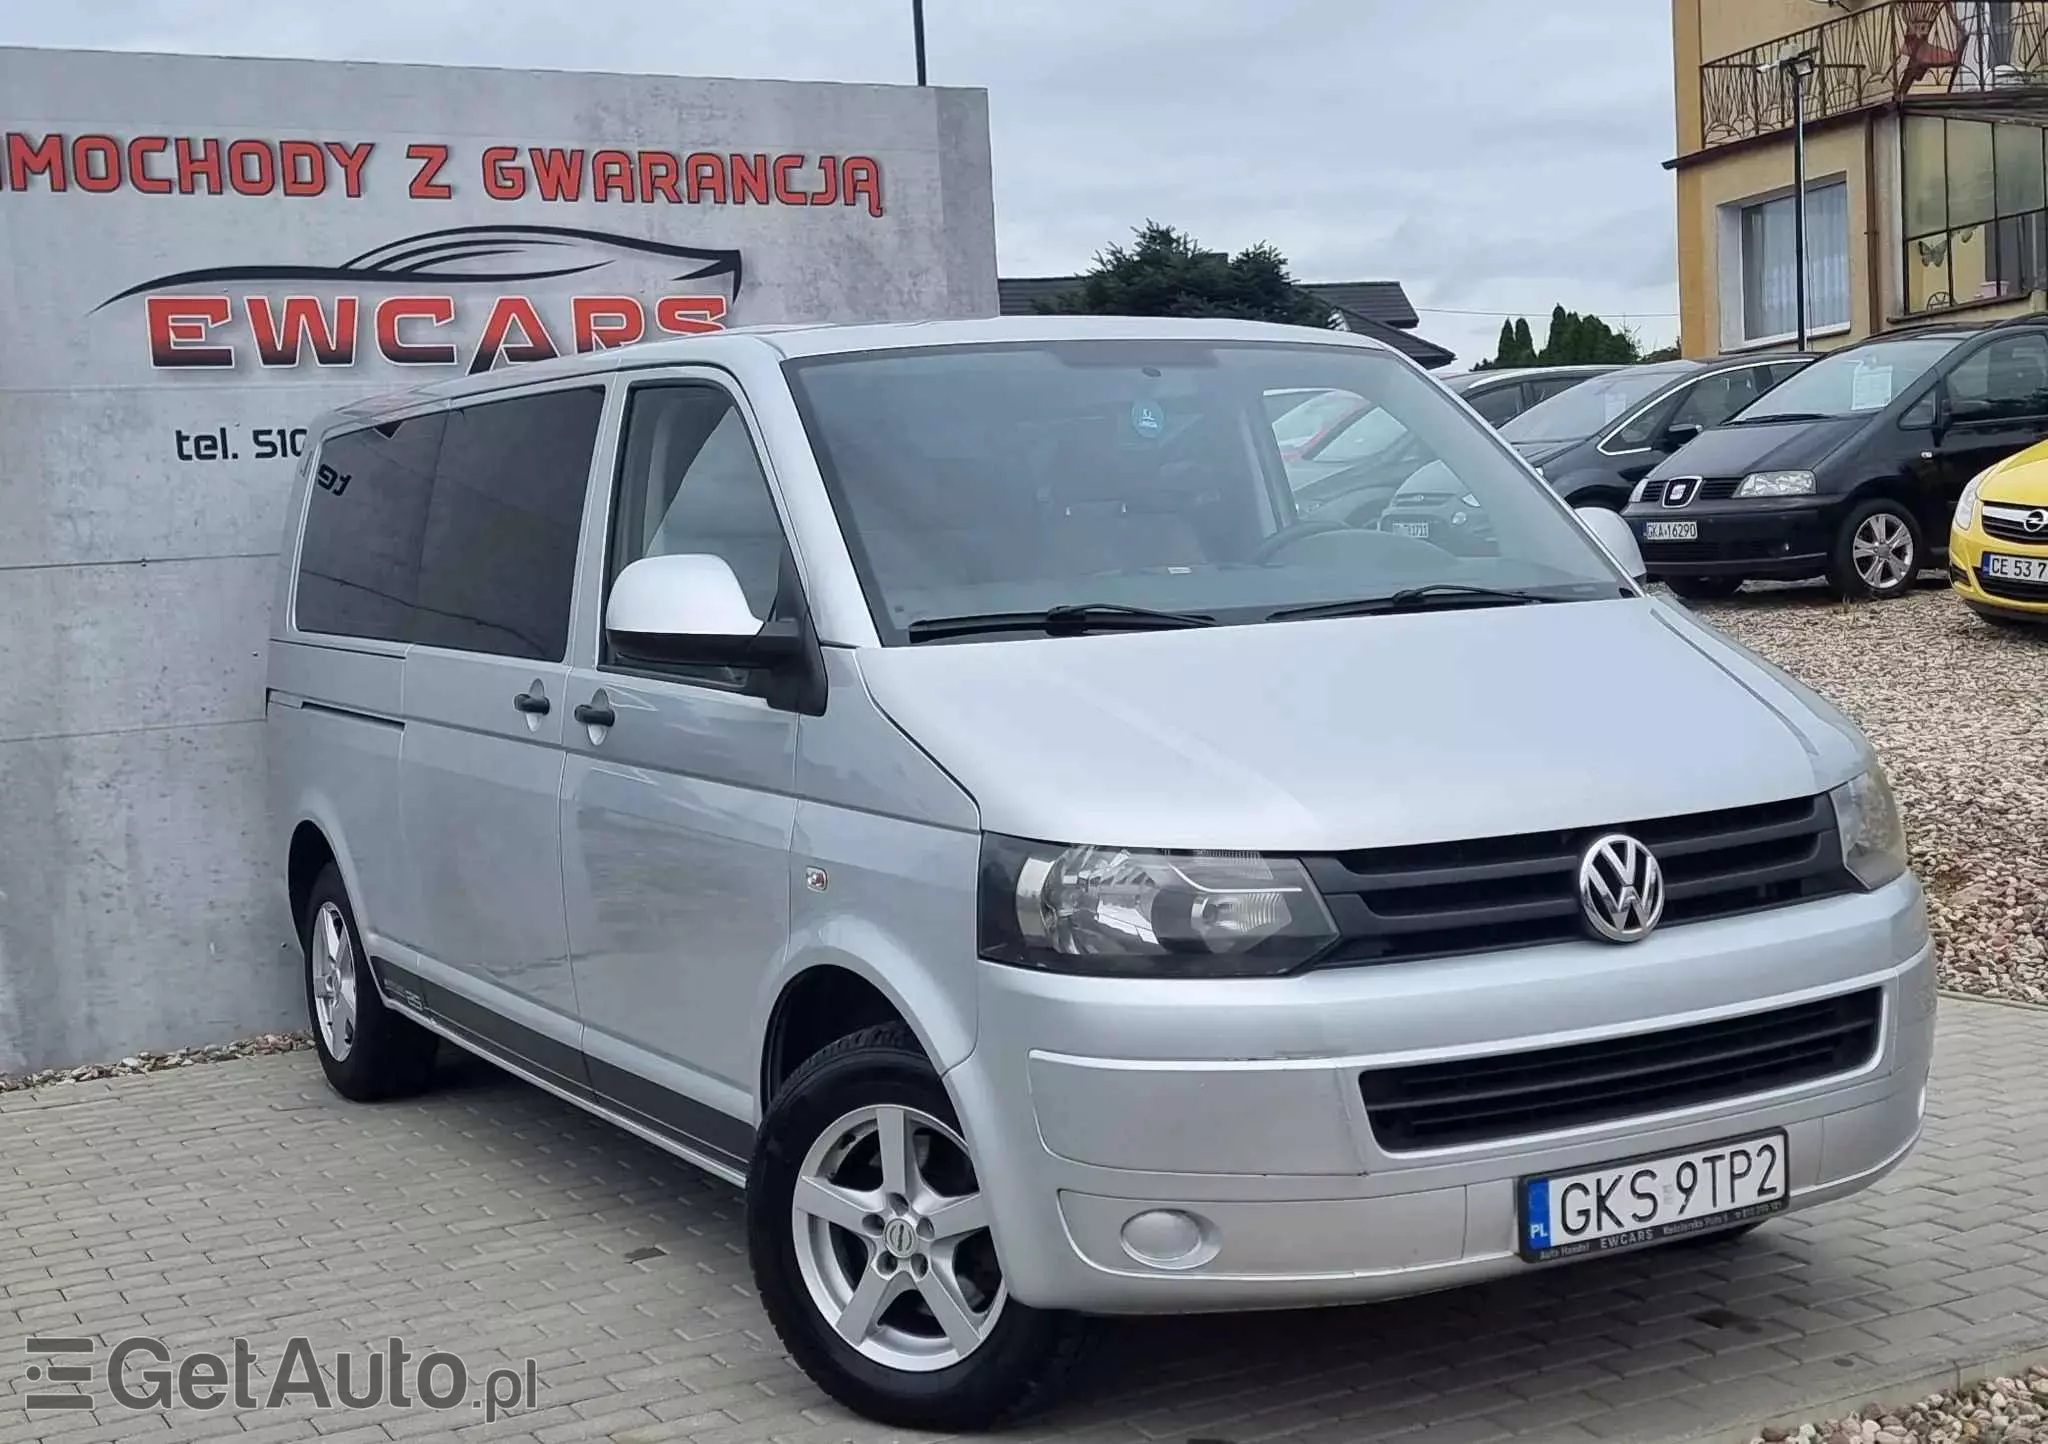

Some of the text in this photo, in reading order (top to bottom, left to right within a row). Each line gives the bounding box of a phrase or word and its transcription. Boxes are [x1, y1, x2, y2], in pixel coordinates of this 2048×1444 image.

[0, 132, 883, 217] MOCHODY Z GWARANCJĄ
[145, 295, 727, 376] EWCARS
[175, 427, 239, 461] tel.
[1667, 523, 1697, 538] 16290
[1991, 557, 2009, 576] CE
[2013, 559, 2032, 578] 53
[1560, 1144, 1778, 1237] GKS 9TP2
[1530, 1223, 1548, 1239] PL
[1600, 1228, 1655, 1249] EWCARS
